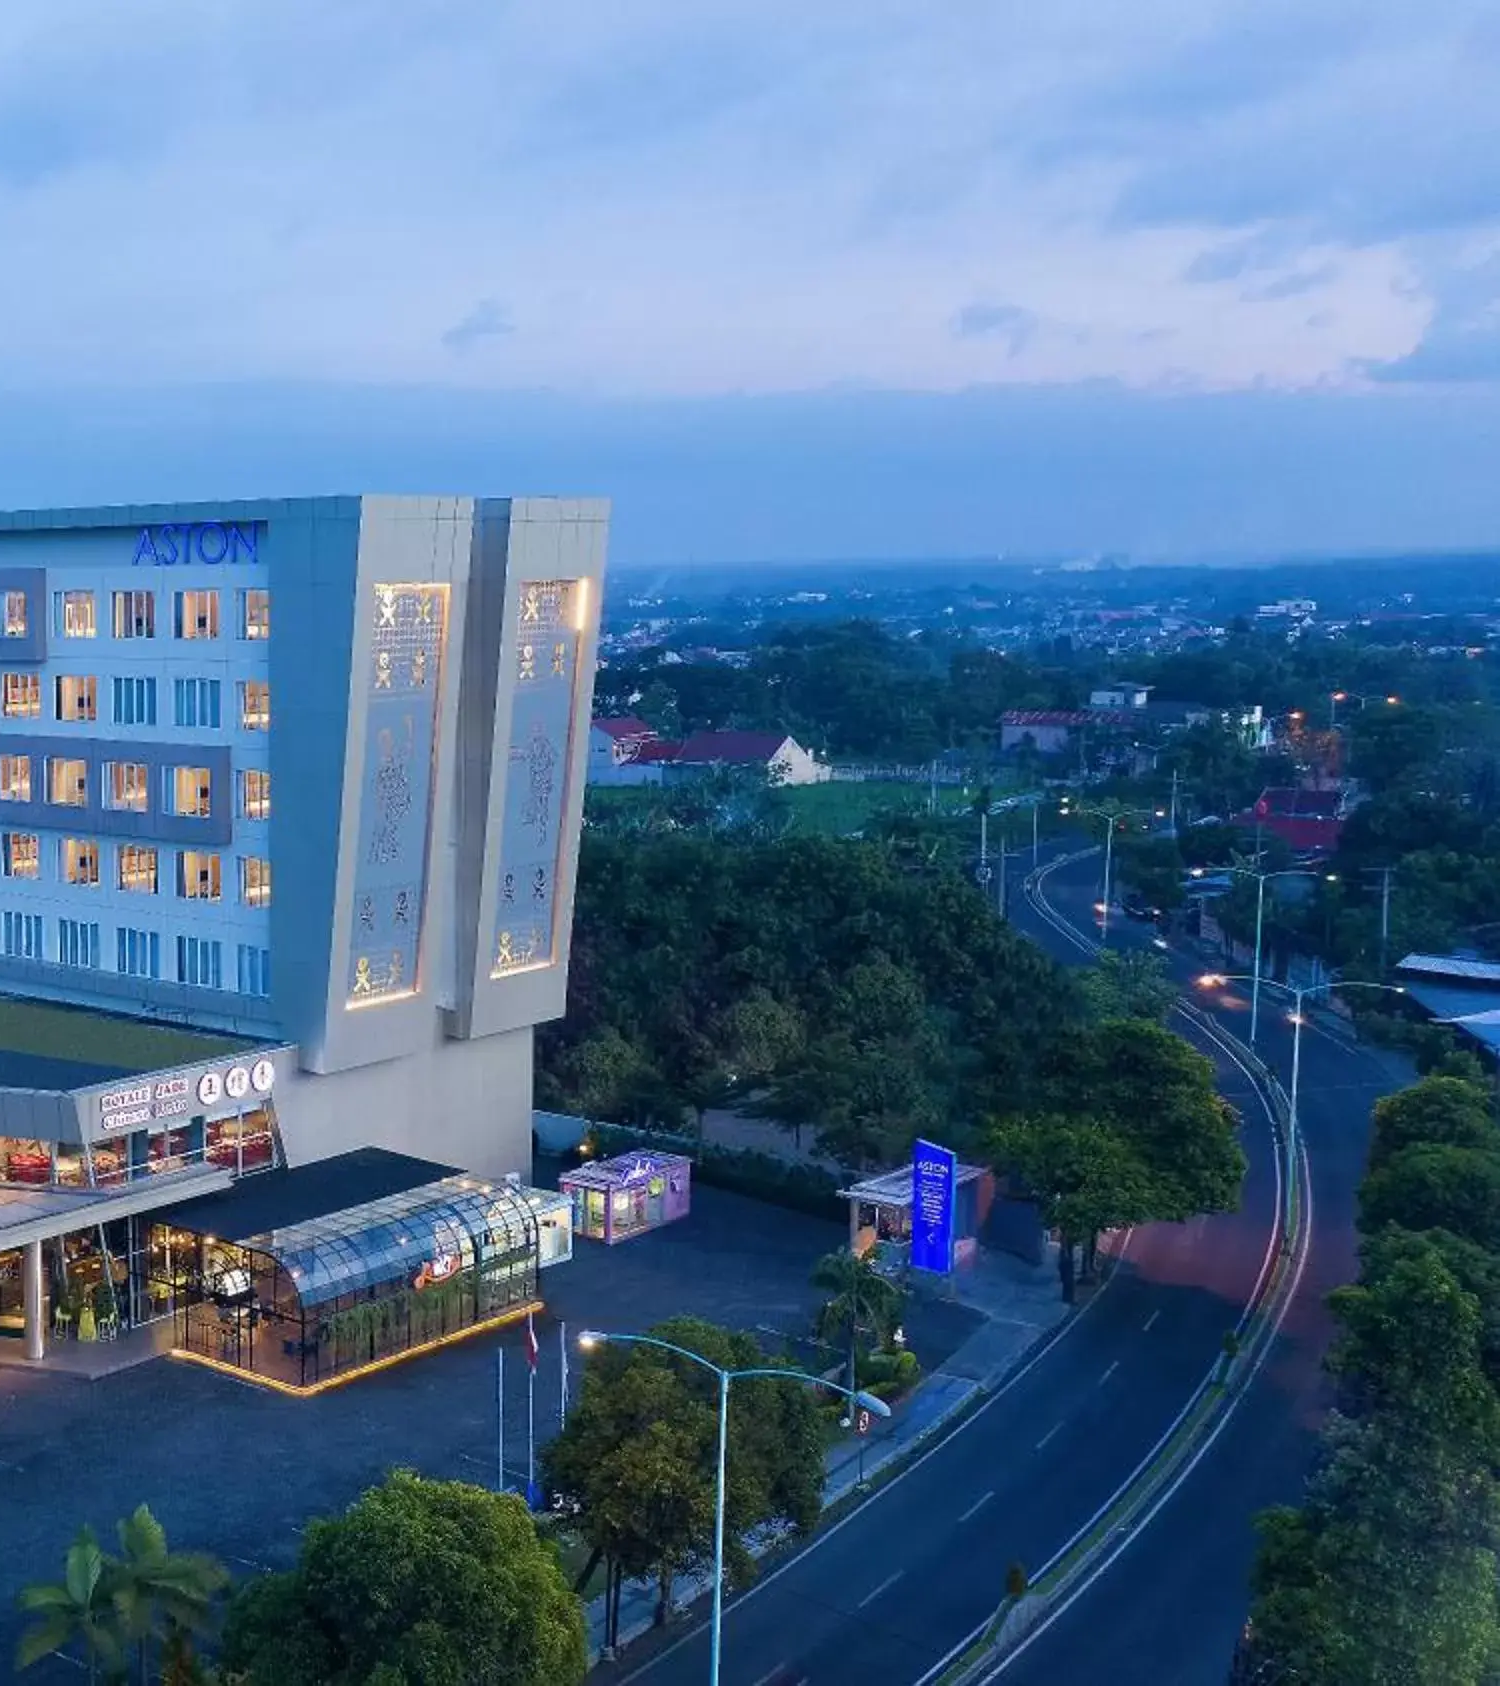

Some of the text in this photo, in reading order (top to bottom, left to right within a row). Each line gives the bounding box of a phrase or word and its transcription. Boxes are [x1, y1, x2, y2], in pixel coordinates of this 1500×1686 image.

[132, 521, 258, 565] ASTON
[101, 1088, 150, 1111] ROYALE
[155, 1078, 188, 1099] JADE
[917, 1161, 948, 1173] ASTON
